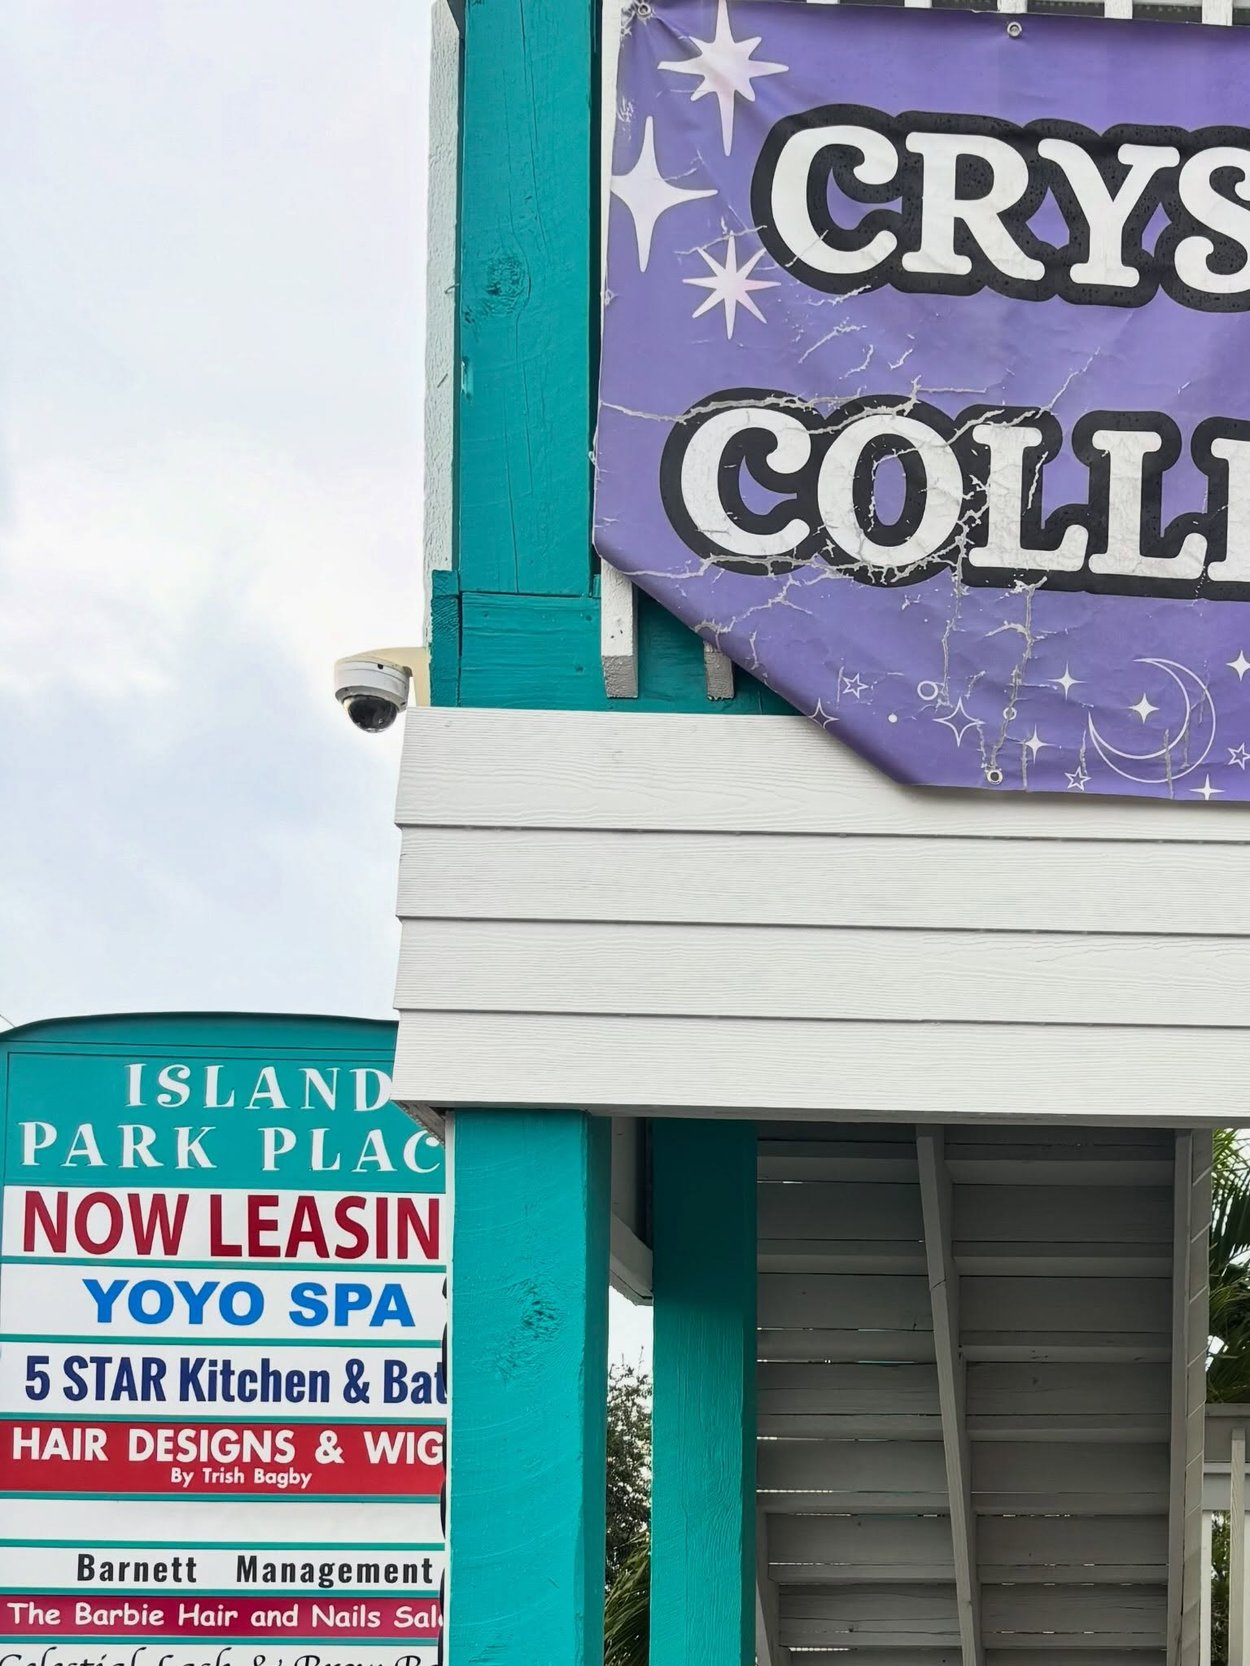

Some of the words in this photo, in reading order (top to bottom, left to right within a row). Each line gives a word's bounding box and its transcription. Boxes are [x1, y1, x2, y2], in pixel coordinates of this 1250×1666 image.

[124, 1063, 392, 1112] ISLAND
[18, 1121, 218, 1169] PARK
[258, 1126, 441, 1174] PLAC
[23, 1190, 190, 1256] NOW
[209, 1193, 440, 1260] LEASIN
[82, 1278, 265, 1326] YOYO
[288, 1282, 416, 1328] SPA
[25, 1355, 50, 1401] 5
[63, 1354, 168, 1402] STAR
[178, 1357, 331, 1404] Kitchen
[343, 1358, 370, 1405] &
[12, 1427, 109, 1462] HAIR
[128, 1428, 296, 1464] DESIGNS
[314, 1430, 345, 1464] &
[363, 1430, 444, 1466] WIG
[170, 1467, 195, 1488] By
[202, 1467, 246, 1485] Trish
[254, 1468, 313, 1489] Bagby
[77, 1553, 198, 1583] Barnett
[235, 1555, 434, 1589] Management
[6, 1601, 61, 1626] The
[75, 1601, 165, 1628] Barbie
[178, 1603, 239, 1628] Hair
[250, 1603, 299, 1629] and
[311, 1604, 381, 1630] Nails
